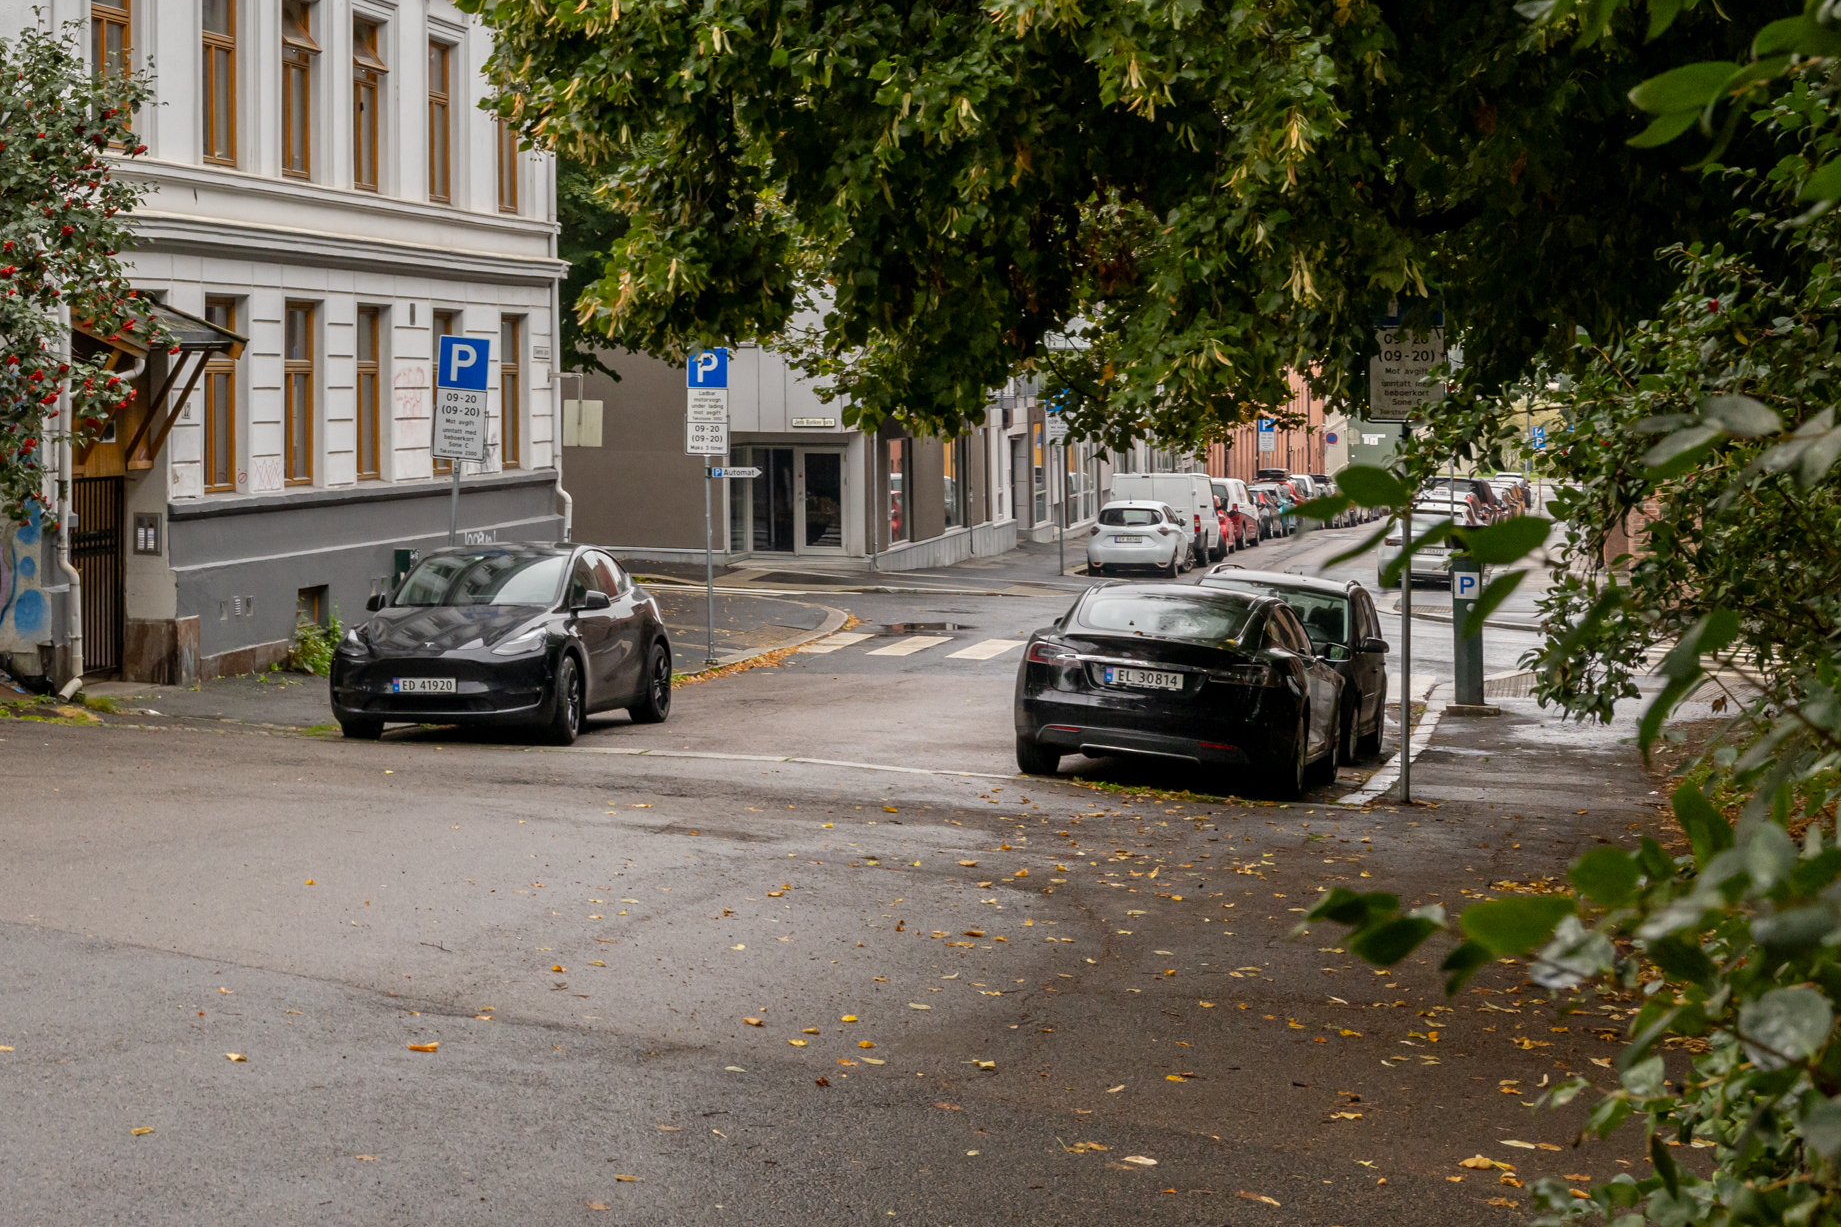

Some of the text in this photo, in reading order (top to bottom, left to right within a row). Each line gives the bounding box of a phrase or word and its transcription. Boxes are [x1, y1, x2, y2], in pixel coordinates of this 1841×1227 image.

[450, 343, 478, 382] P
[697, 352, 719, 383] P
[1415, 379, 1428, 387] me
[1384, 389, 1429, 397] beboerkort
[1392, 398, 1412, 406] Sone
[458, 418, 475, 427] avgift
[442, 427, 463, 435] unntatt
[443, 434, 474, 442] beboerkort
[448, 441, 462, 449] Sone
[1459, 576, 1475, 595] P
[1118, 669, 1178, 687] EL 30814
[402, 680, 453, 691] ED 41920
